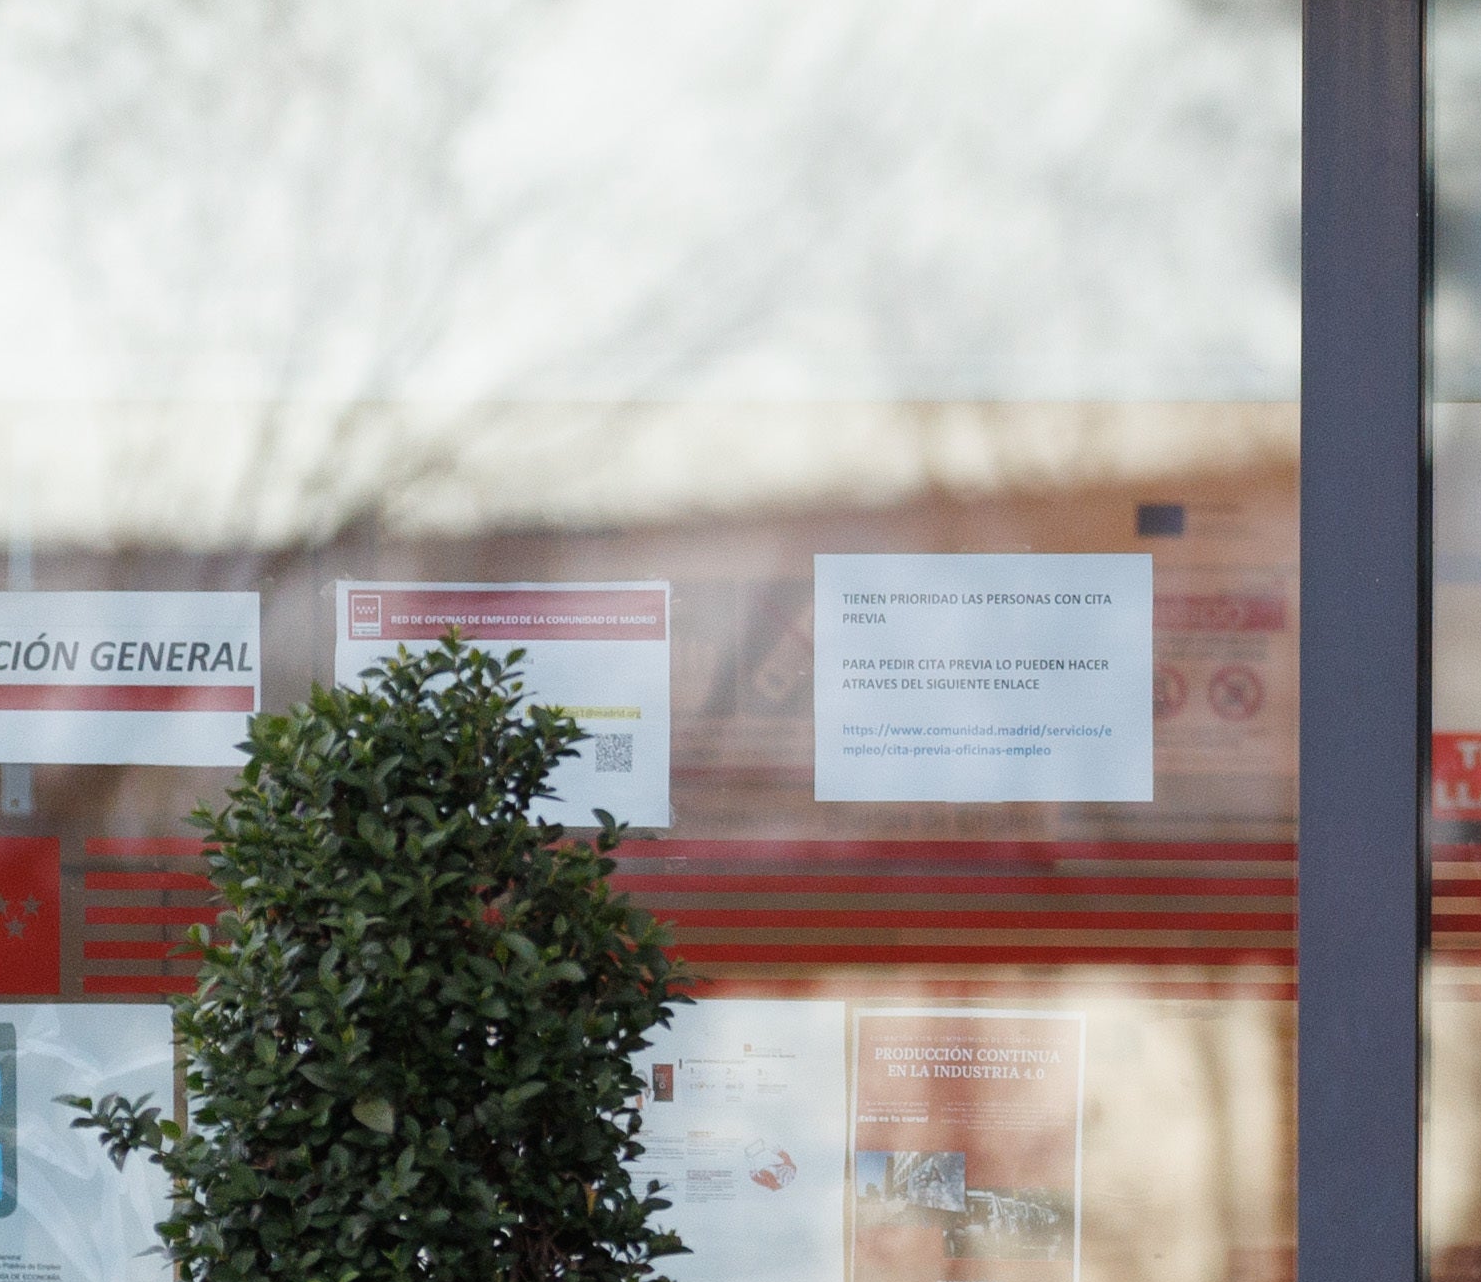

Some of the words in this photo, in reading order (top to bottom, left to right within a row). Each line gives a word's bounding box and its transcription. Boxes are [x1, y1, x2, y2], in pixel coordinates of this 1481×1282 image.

[842, 594, 886, 605] TIENEN
[890, 594, 958, 605] PRIORIDAD
[962, 594, 983, 605] LAS
[987, 594, 1051, 605] PERSONAS
[1054, 594, 1081, 605] CON
[1085, 594, 1111, 605] CITA
[842, 613, 886, 624] PREVIA
[89, 640, 255, 673] GENERAL
[842, 659, 875, 670] PARA
[879, 659, 915, 670] PEDIR
[918, 659, 946, 670] CITA
[949, 659, 993, 670] PREVIA
[996, 659, 1011, 670] LO
[1015, 659, 1064, 670] PUEDEN
[1068, 659, 1109, 670] HACER
[842, 679, 897, 690] ATRAVES
[901, 679, 923, 690] DEL
[927, 679, 990, 690] SIGUIENTE
[994, 679, 1040, 690] ENLACE
[875, 1046, 973, 1061] PRODUCCIÓN
[977, 1049, 1061, 1063] CONTINUA
[888, 1065, 906, 1077] EN
[910, 1065, 929, 1077] LA
[935, 1065, 1019, 1079] INDUSTRIA
[1023, 1068, 1044, 1079] 4.0
